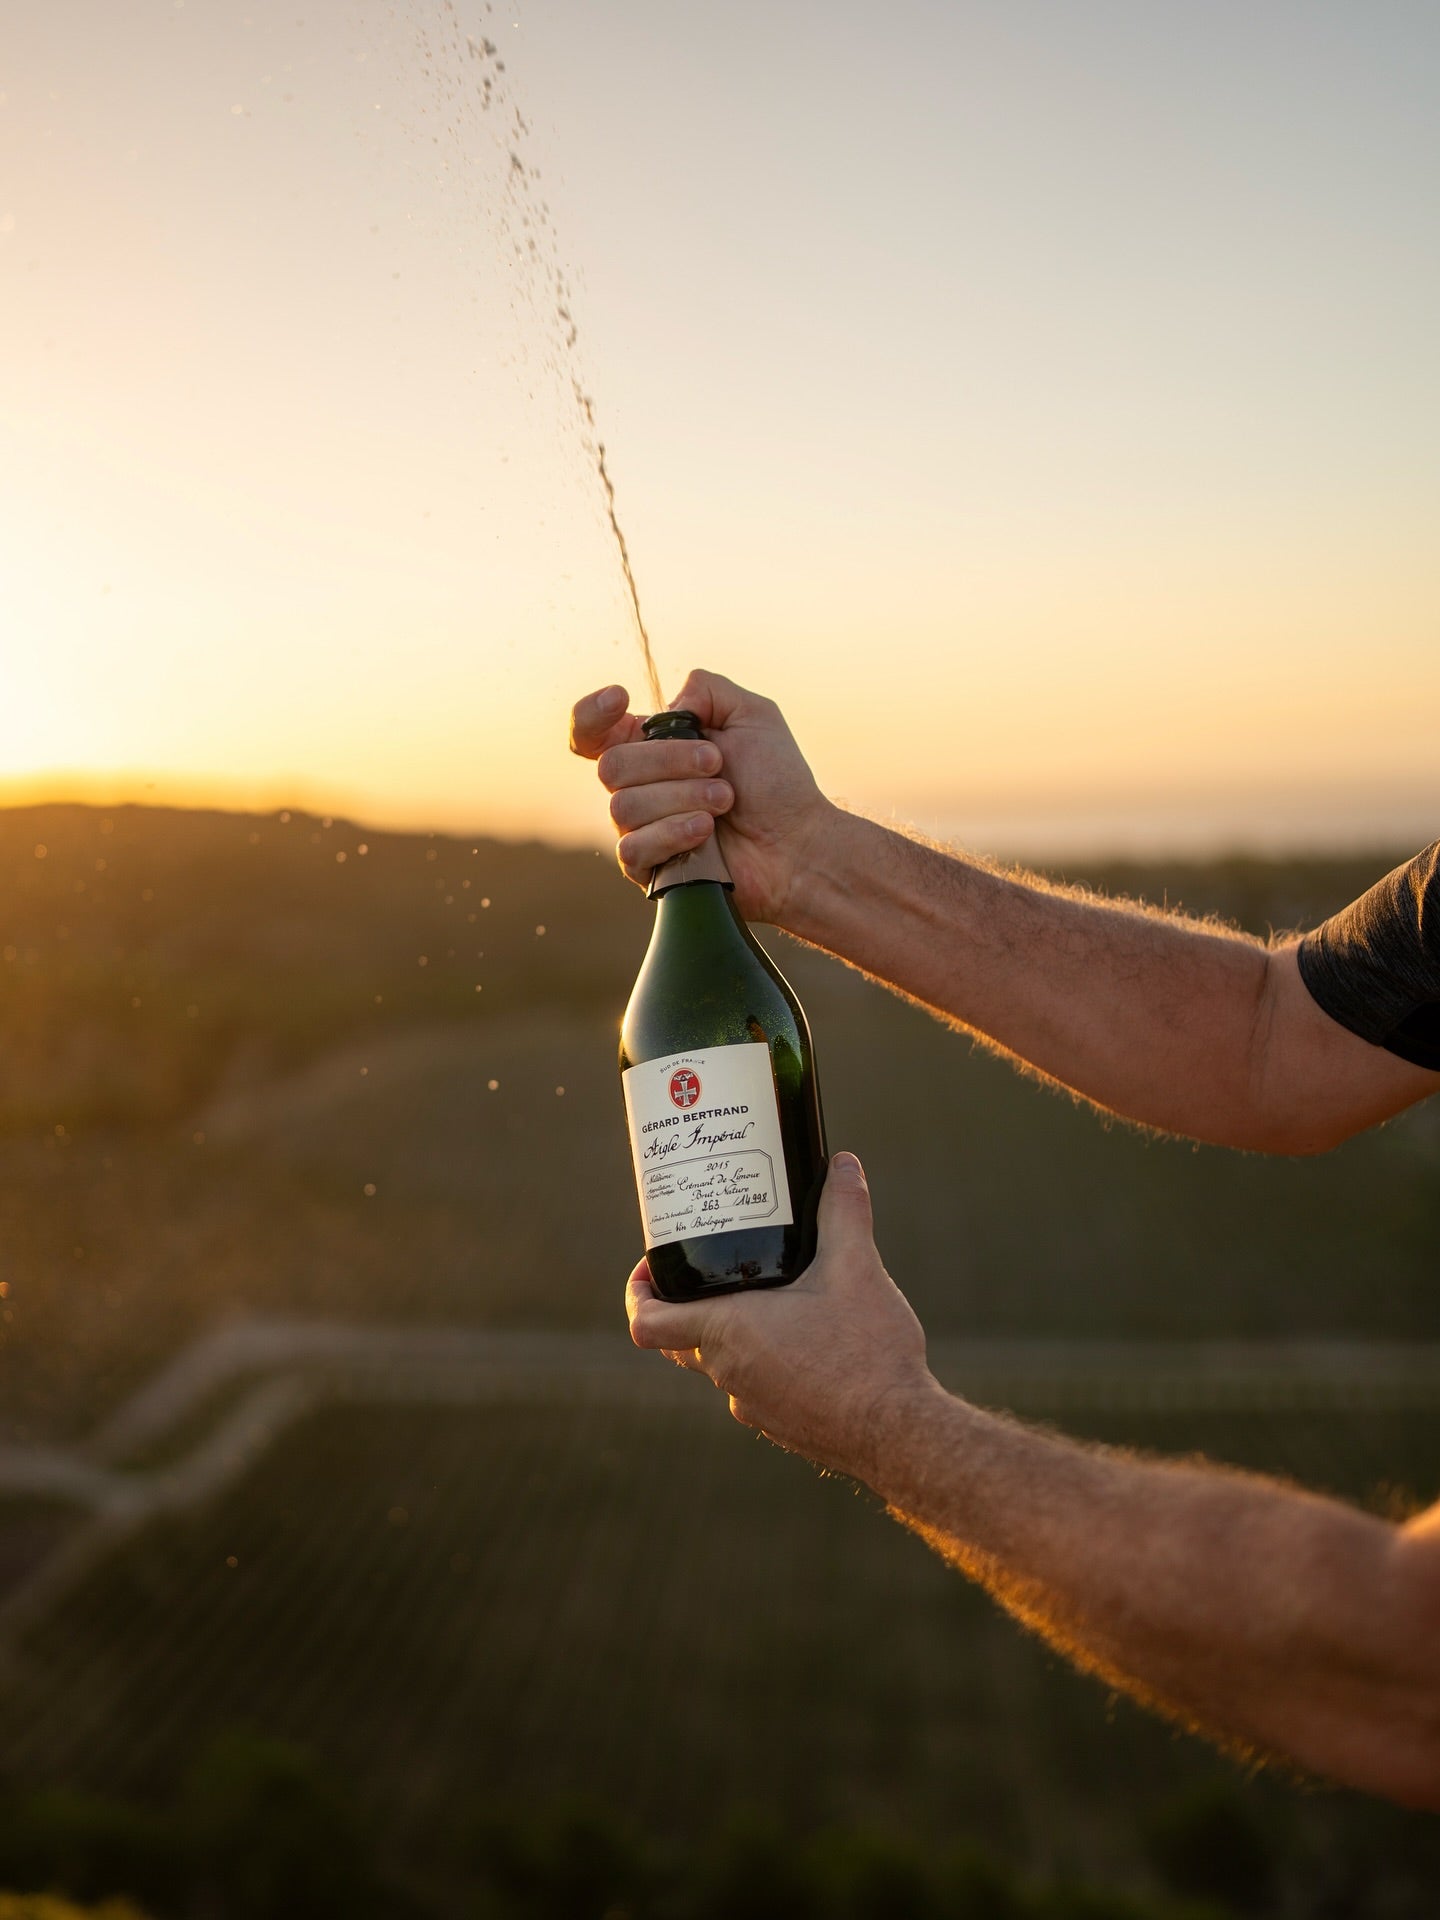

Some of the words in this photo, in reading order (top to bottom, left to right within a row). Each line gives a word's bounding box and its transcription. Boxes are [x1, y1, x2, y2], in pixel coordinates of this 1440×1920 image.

[642, 1116, 680, 1134] GÉRARD
[683, 1105, 749, 1123] BERTRAND
[643, 1134, 681, 1160] Aigle
[683, 1122, 755, 1152] Impérial
[704, 1160, 730, 1172] 2015
[691, 1189, 714, 1201] Brut
[716, 1183, 749, 1197] Nature
[676, 1221, 687, 1232] Vin
